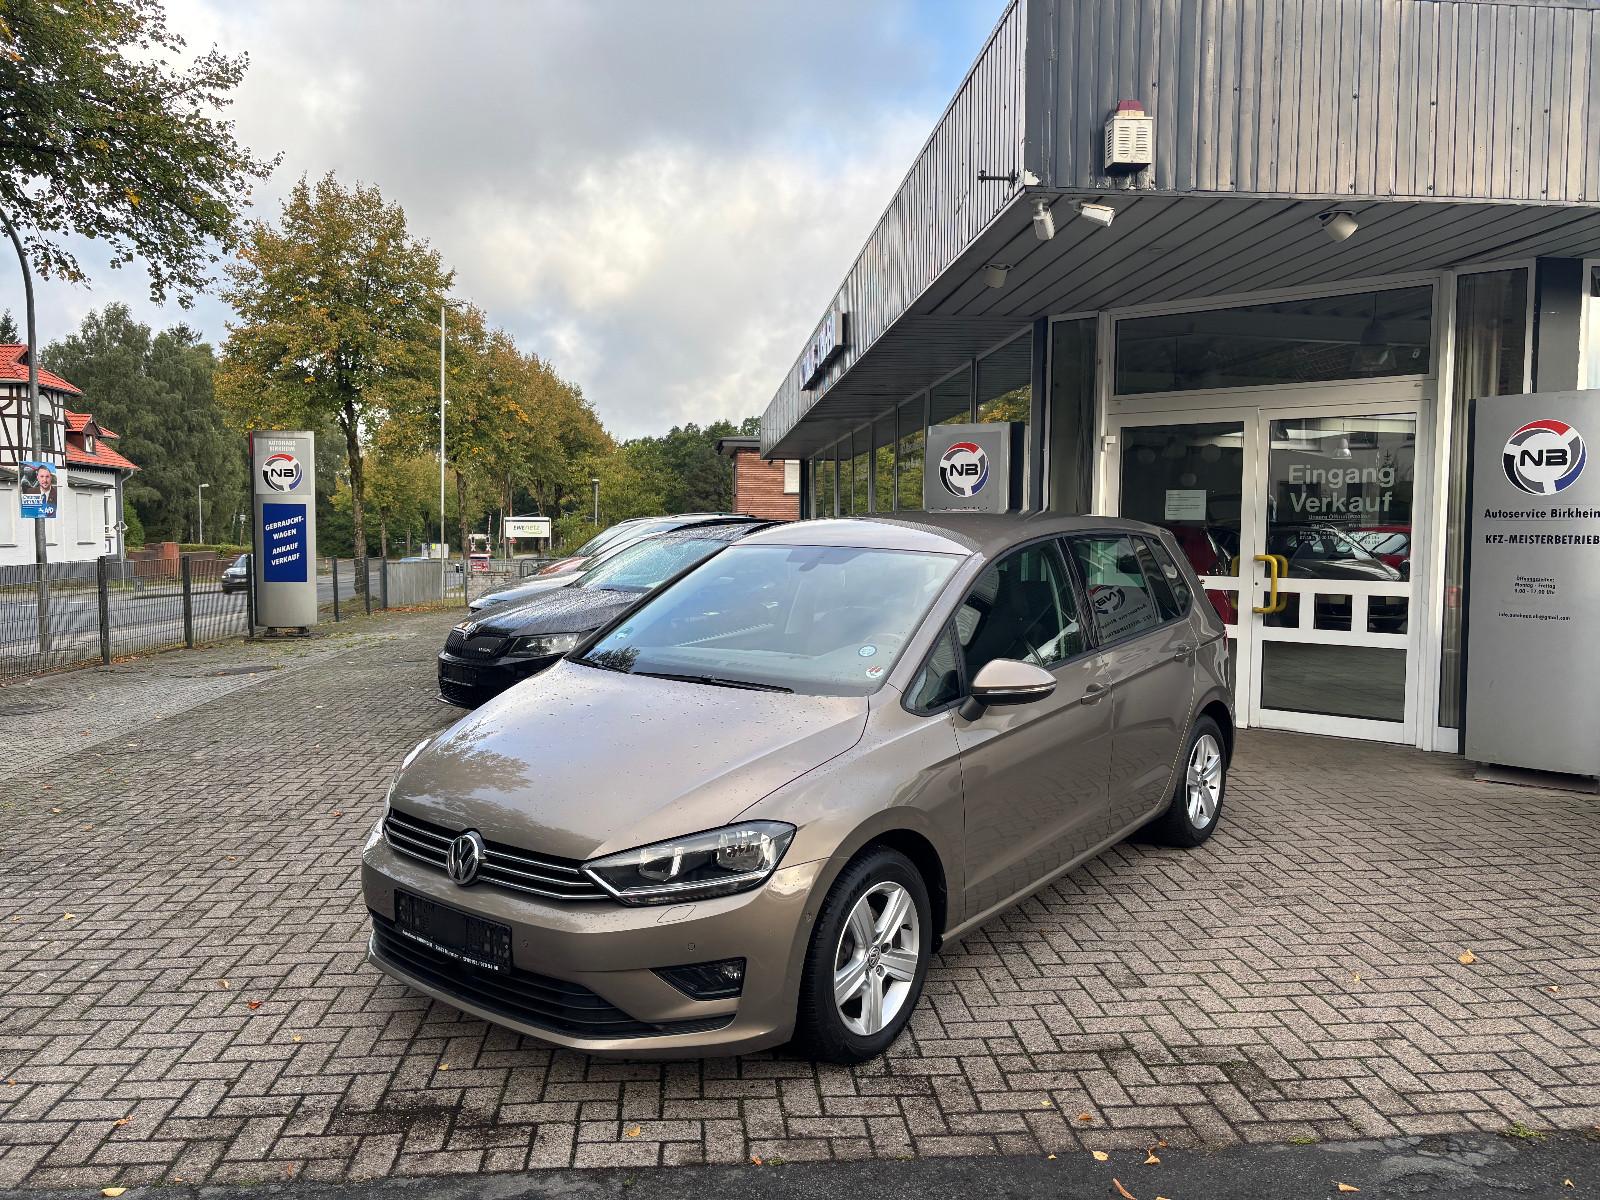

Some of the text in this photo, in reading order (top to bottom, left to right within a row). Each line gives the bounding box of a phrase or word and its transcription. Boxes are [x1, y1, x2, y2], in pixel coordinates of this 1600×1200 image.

[1519, 448, 1569, 467] NB
[270, 468, 295, 478] NB
[949, 463, 979, 477] NB
[1288, 464, 1395, 488] Eingang
[1289, 491, 1393, 513] Verkauf
[1484, 508, 1547, 519] Autoservice
[265, 515, 304, 531] GEBRAUCHT-
[272, 528, 297, 540] WAGEN
[1485, 534, 1600, 545] KFZ-MEISTERBETRIEB
[272, 542, 299, 555] ANKAUF
[271, 552, 300, 566] VERKAUF
